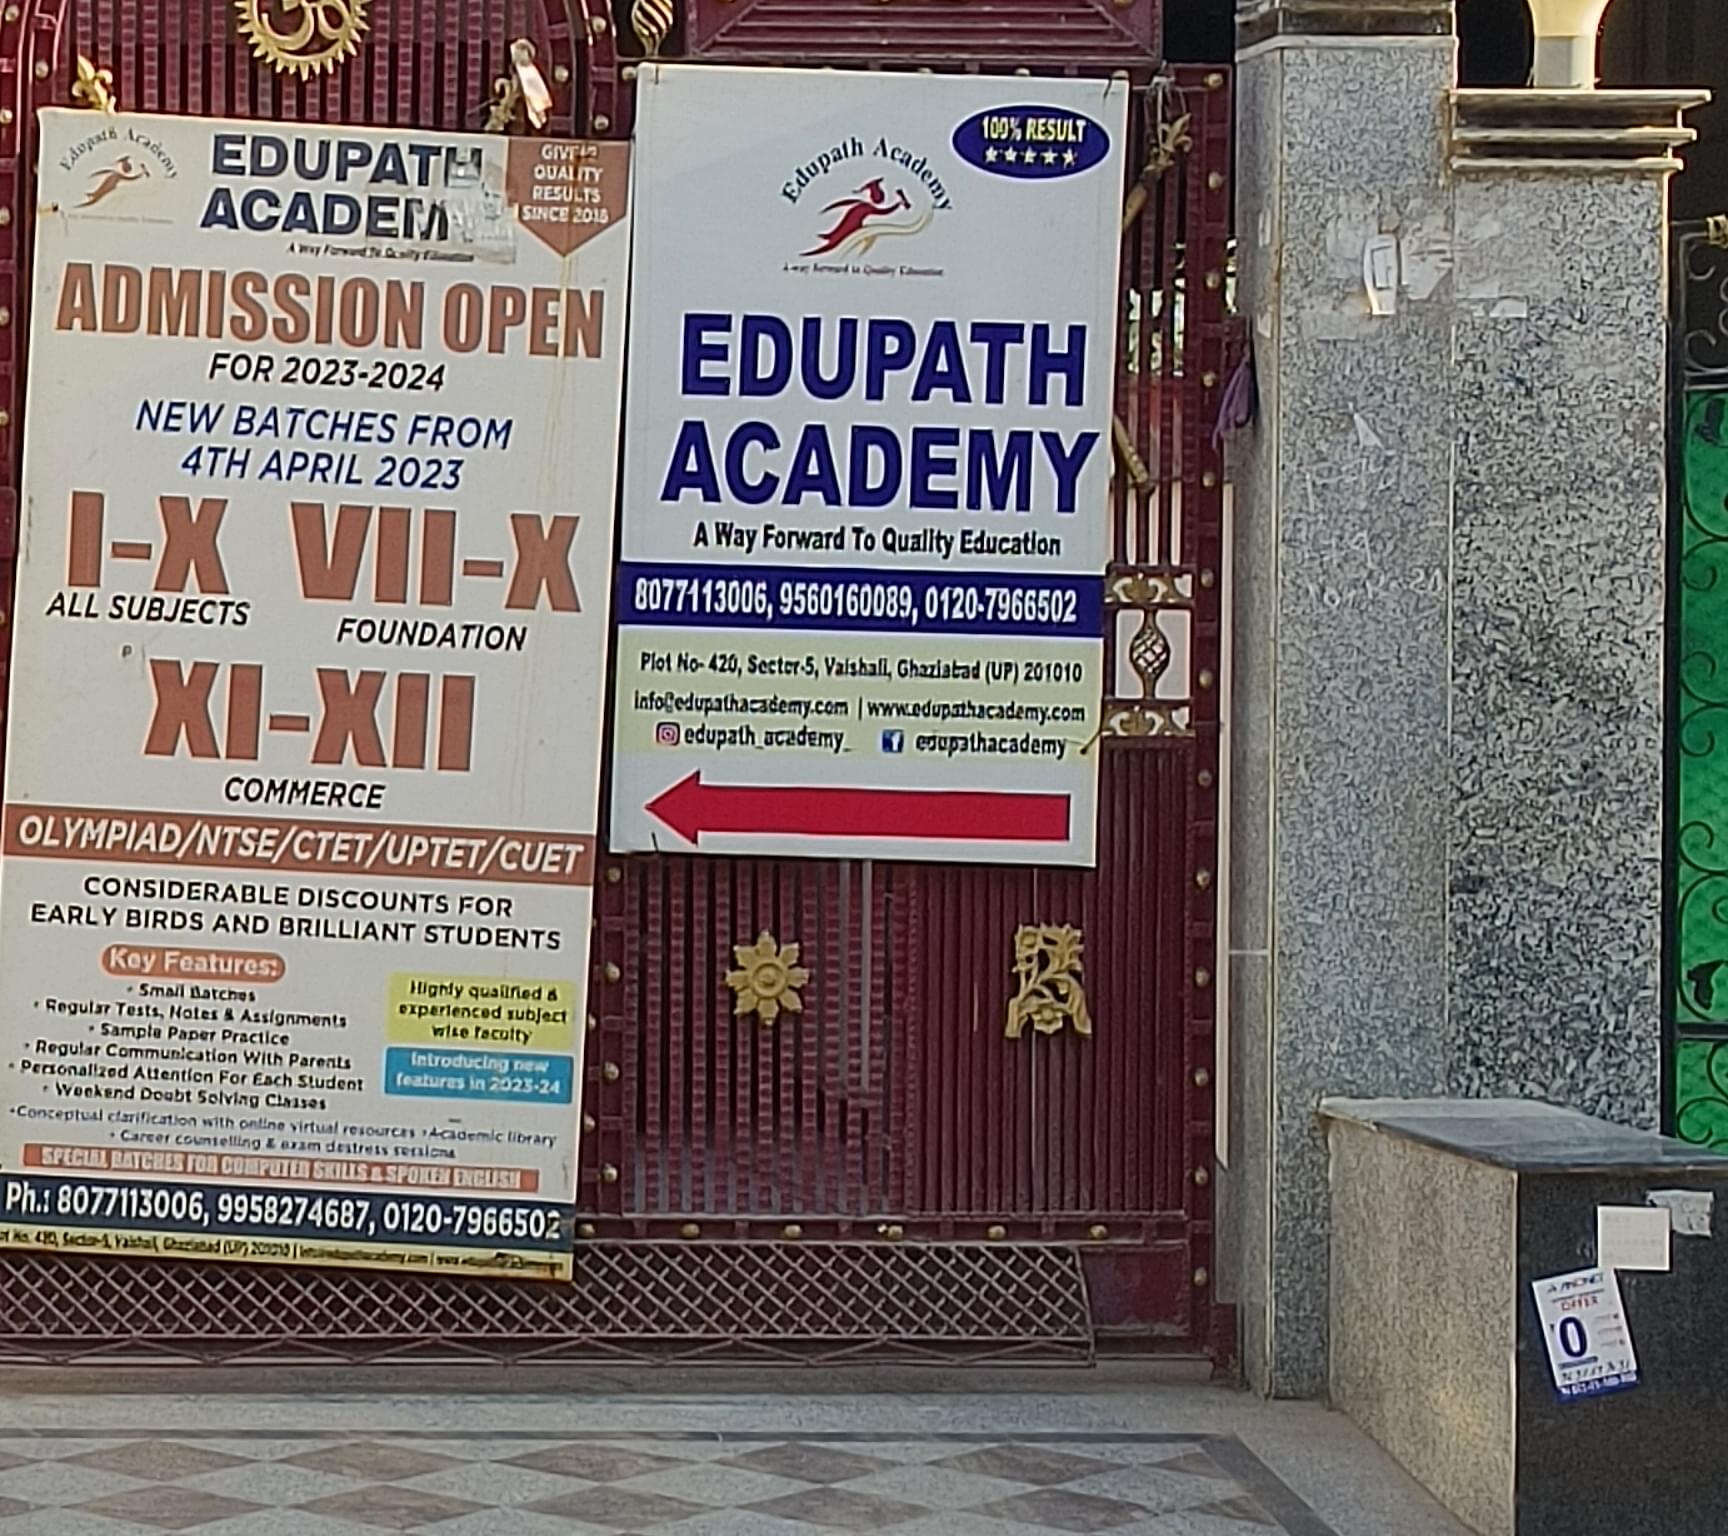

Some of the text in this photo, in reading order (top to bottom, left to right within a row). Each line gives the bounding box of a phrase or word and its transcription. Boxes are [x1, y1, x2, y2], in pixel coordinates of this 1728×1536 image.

[981, 116, 1088, 144] 100% RESULT
[211, 133, 483, 189] EDUPATH
[780, 136, 953, 211] Edupath Academy
[522, 204, 569, 223] SINCE
[532, 186, 601, 204] RESULTS
[199, 187, 473, 242] ACADEM
[55, 261, 605, 359] ADMISSION OPEN
[208, 352, 447, 392] FOR 2023-2024
[681, 312, 1087, 407] EDUPATH
[135, 399, 514, 450] NEW BATCHES FROM
[180, 445, 465, 491] 4TH APRIL 2023
[660, 419, 1101, 514] ACADEMY
[68, 489, 582, 613] I-X VII-X
[692, 521, 1062, 560] A Way Forward To Quality Education
[45, 592, 251, 627] ALL SUBJECTS
[634, 577, 1078, 626] 8077113006, 9560160089, 0120-7966502
[336, 617, 527, 652] FOUNDATION
[639, 651, 672, 673] Plot
[708, 653, 743, 679] 420,
[747, 654, 820, 680] Sector-5,
[897, 658, 981, 680] Ghaziabad
[984, 660, 1020, 686] (UP)
[1023, 662, 1083, 683] 201010
[144, 658, 475, 772] XI-XII
[915, 731, 1067, 761] edupathacademy
[223, 777, 387, 810] COMMERCE
[19, 814, 585, 875] OLYMPIAD/NTSE/CTET/UPTET/CUET
[83, 876, 513, 918] CONSIDERABLE DISCOUNTS FOR
[30, 903, 562, 950] EARLY BIRDS AND BRILLIANT STUDENTS
[109, 947, 278, 977] Key Features:
[138, 982, 185, 999] Small
[409, 980, 464, 1000] Highly
[45, 998, 111, 1018] Regular
[240, 1008, 348, 1030] Assignments
[507, 1006, 568, 1026] subject
[100, 1023, 290, 1046] Sample Paper Practice
[34, 1039, 353, 1070] Regular Communication With Parents
[133, 1065, 213, 1084] Attention
[219, 1070, 248, 1085] For
[252, 1071, 293, 1088] Each
[298, 1073, 365, 1092] Student
[197, 1088, 260, 1109] Solving
[5, 1180, 561, 1240] Ph.: 8077113006, 9958274687, 0120-7966502
